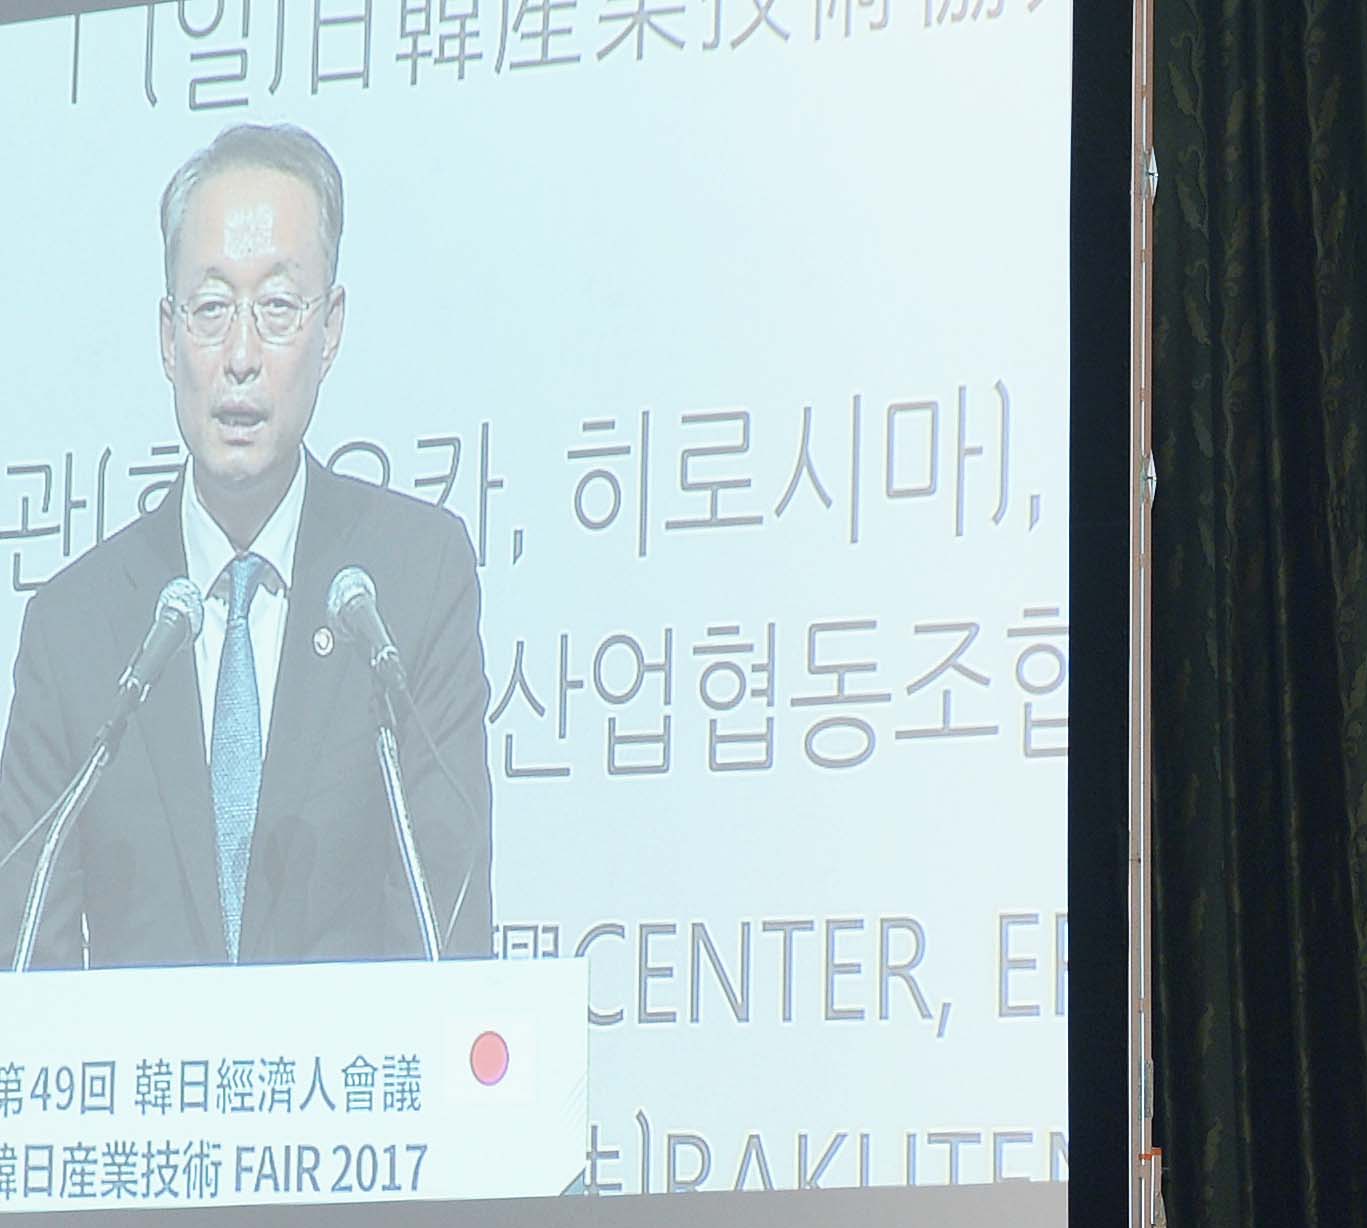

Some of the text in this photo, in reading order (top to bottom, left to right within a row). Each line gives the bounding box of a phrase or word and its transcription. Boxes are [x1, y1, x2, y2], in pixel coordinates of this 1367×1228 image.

[567, 380, 1040, 558] 히로시마),
[998, 912, 1069, 1018] E
[134, 1053, 422, 1116] 韓日經濟人會議
[234, 1144, 321, 1193] FAIR
[330, 1143, 428, 1193] 2017
